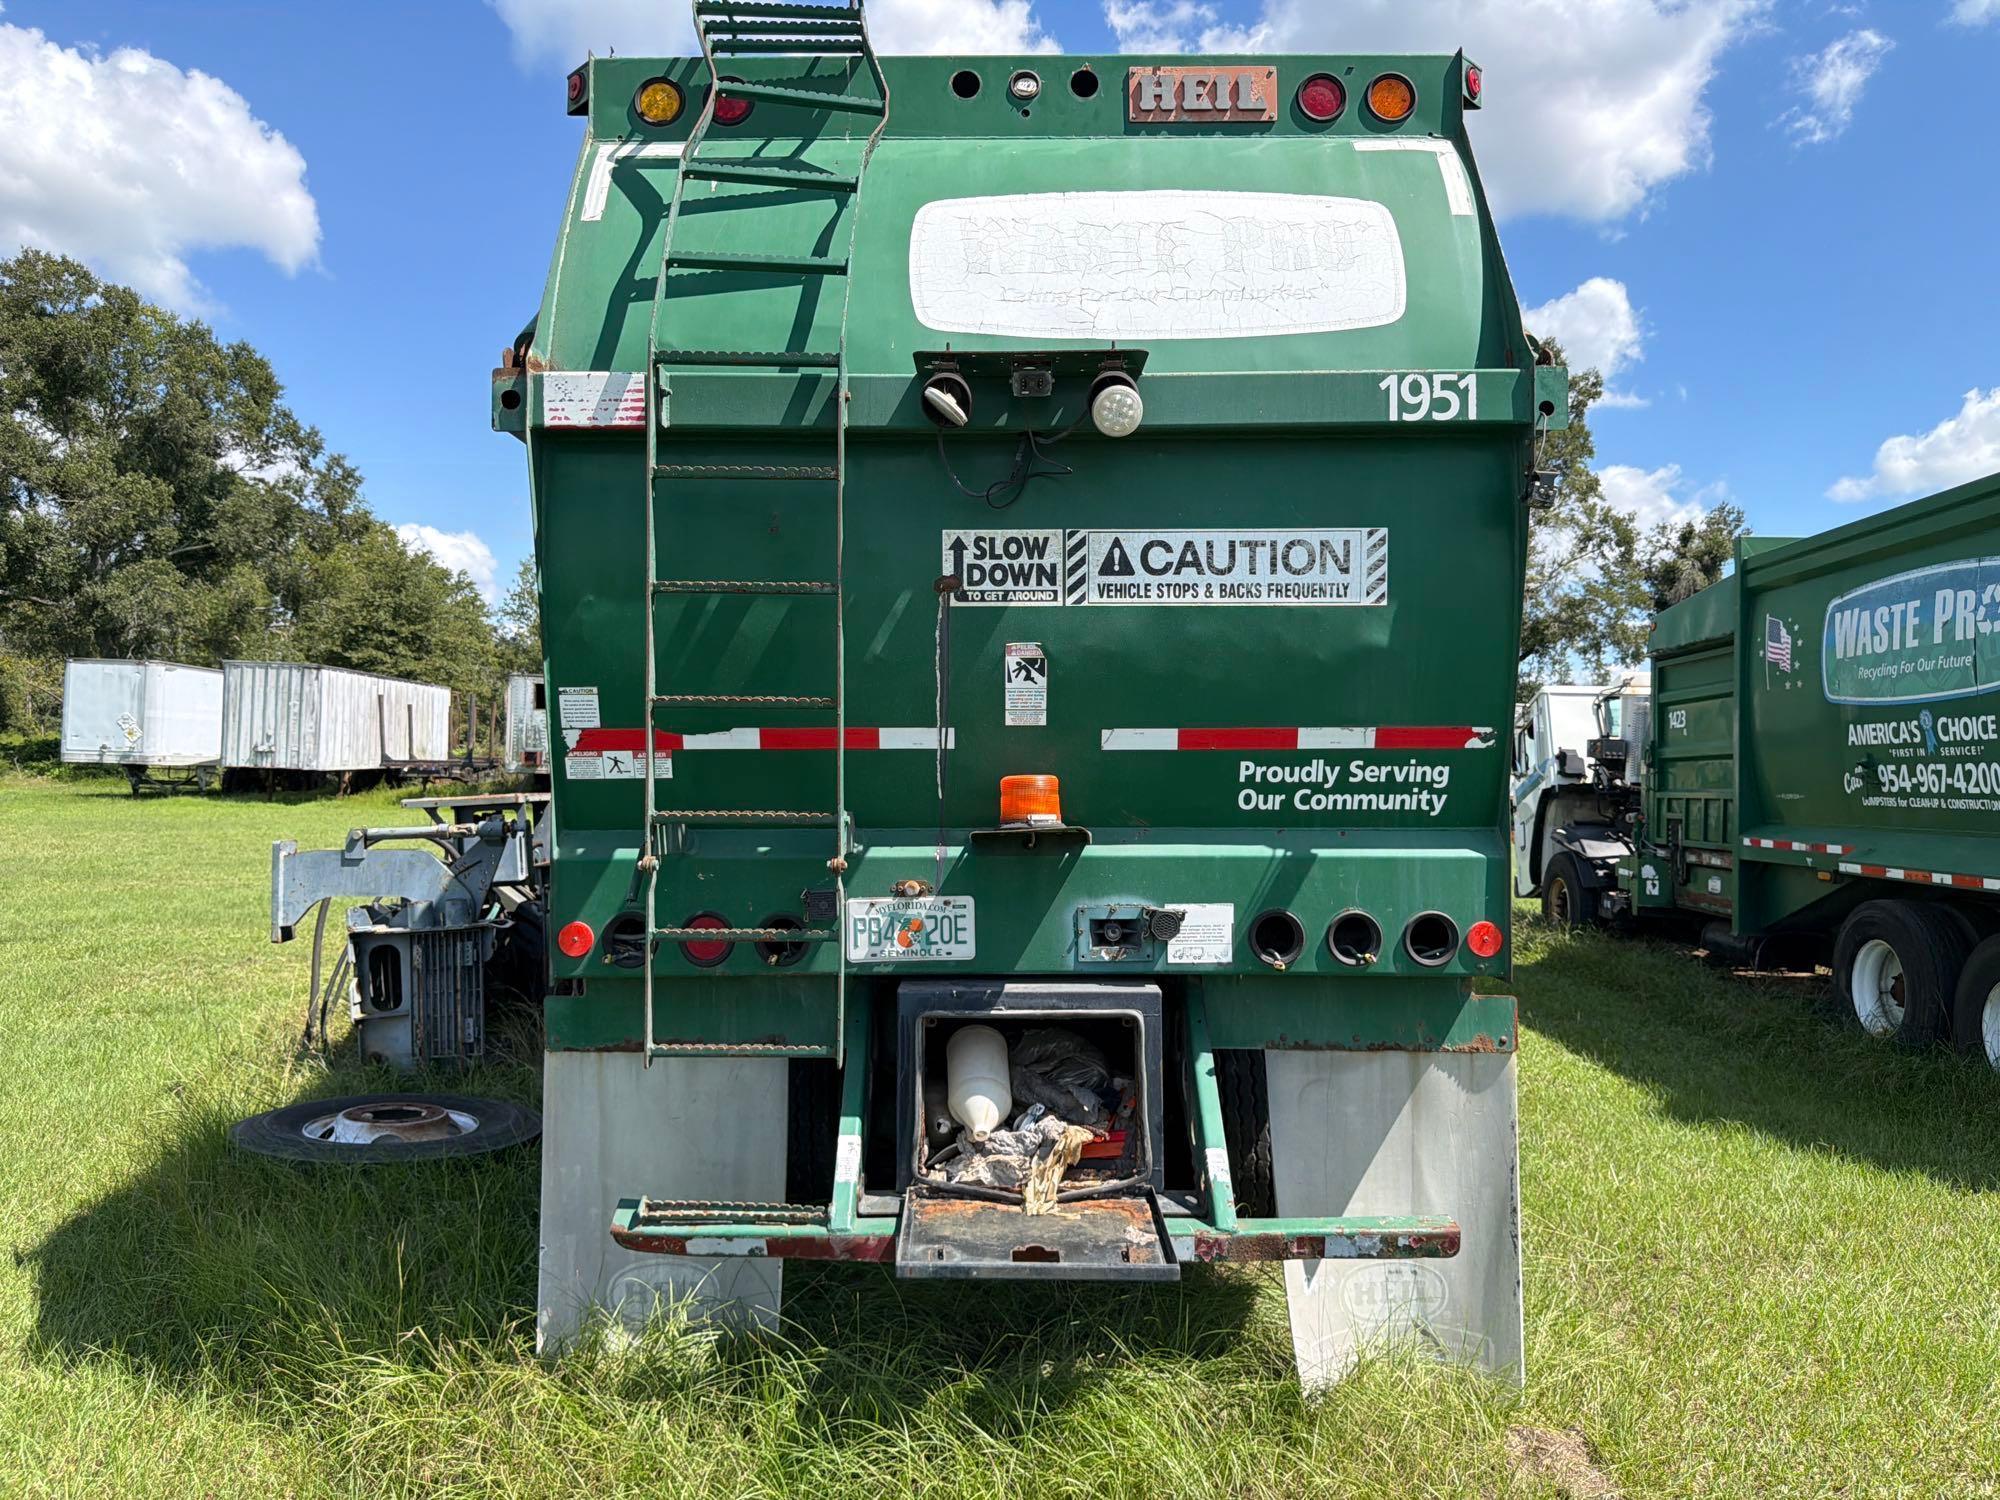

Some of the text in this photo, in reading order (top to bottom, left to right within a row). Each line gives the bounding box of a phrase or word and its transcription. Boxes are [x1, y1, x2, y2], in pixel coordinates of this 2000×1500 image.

[1139, 74, 1267, 110] HEIL
[1378, 373, 1477, 421] 1951
[973, 535, 1050, 560] SLOW
[1139, 538, 1351, 576] CAUTION
[966, 563, 1057, 587] DOWN
[966, 591, 1055, 601] TO GET AROUND
[1097, 583, 1351, 600] VEHICLE STOPS & BACKS FREQUENTLY
[1834, 599, 1921, 659] WASTE
[1858, 655, 1972, 681] Recycling For Our Future
[1668, 711, 1686, 729] 1423
[1848, 715, 1998, 746] AMERICA'S CHOICE
[1916, 747, 1926, 757] IN
[1239, 759, 1450, 788] Proudly Serving
[1877, 762, 2000, 795] 954-967-4200
[1238, 787, 1448, 816] Our Community
[1897, 797, 1908, 807] for
[1909, 797, 1939, 809] CLEAN-UP
[1941, 798, 1948, 808] &
[873, 901, 947, 916] MYFLORIDA.COM
[925, 913, 967, 947] 20E
[880, 947, 943, 959] SEMINOLE
